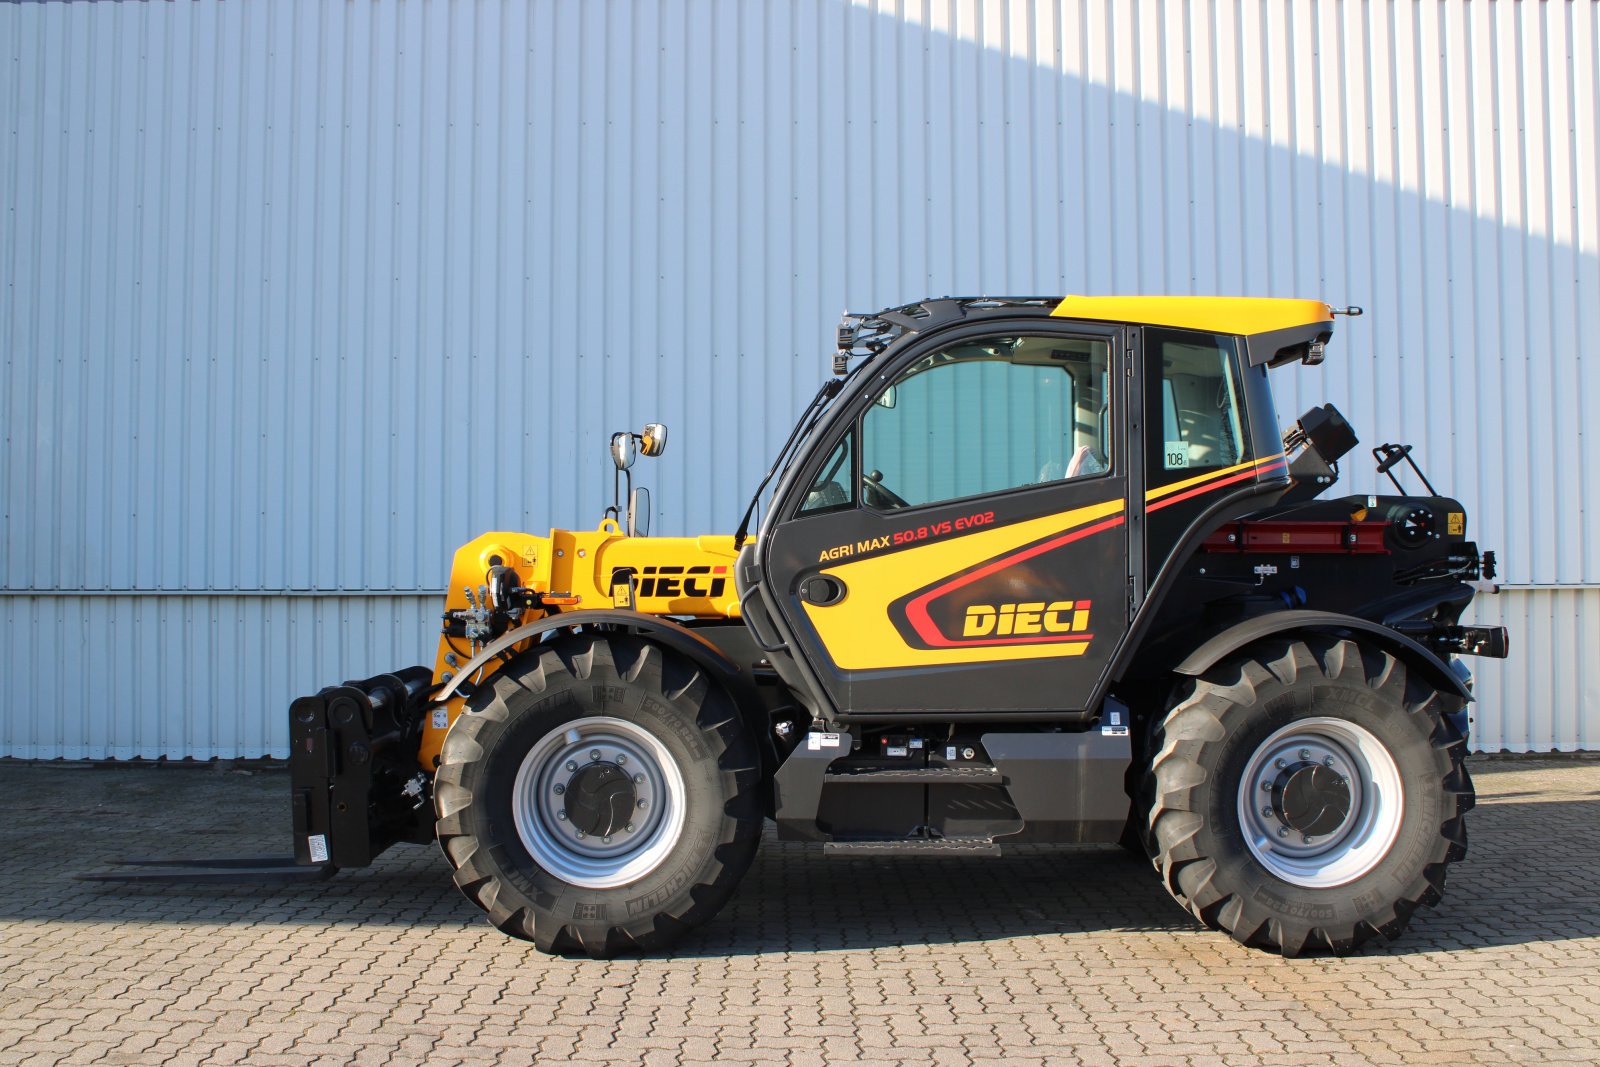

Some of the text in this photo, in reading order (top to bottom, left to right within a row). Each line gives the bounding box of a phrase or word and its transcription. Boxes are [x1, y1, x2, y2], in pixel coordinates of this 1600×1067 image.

[1167, 453, 1183, 466] 108
[818, 511, 995, 562] AGRI MAX 50.8 VS EVO2
[963, 599, 1092, 637] DIECI
[643, 699, 683, 728] 500/70
[625, 851, 701, 918] MICHELIN
[1289, 906, 1333, 918] 500/70
